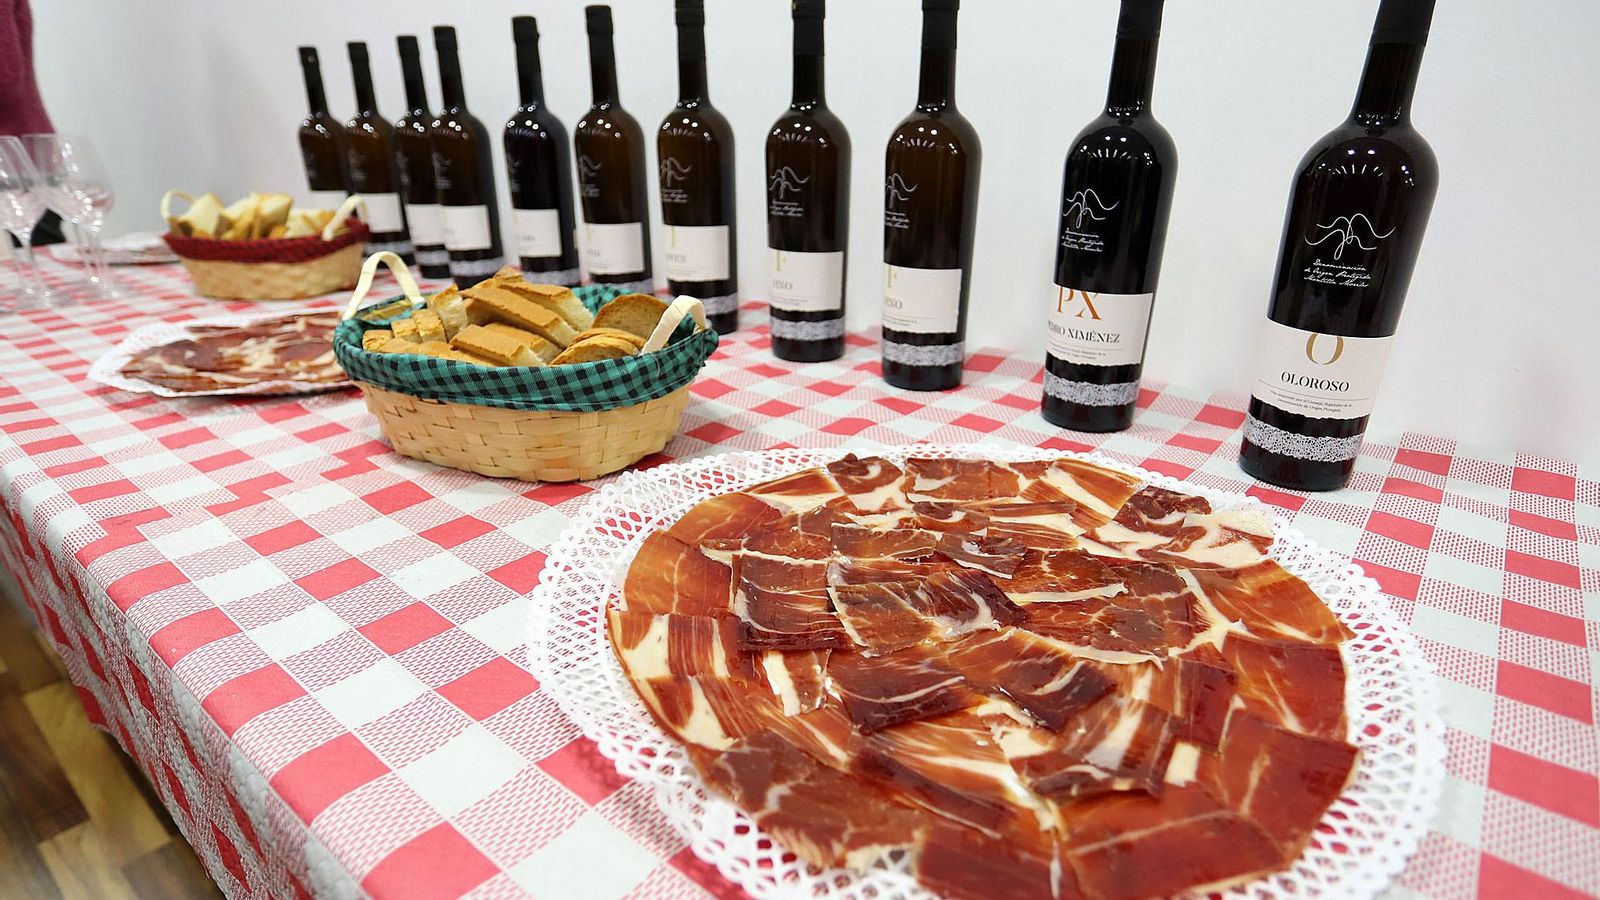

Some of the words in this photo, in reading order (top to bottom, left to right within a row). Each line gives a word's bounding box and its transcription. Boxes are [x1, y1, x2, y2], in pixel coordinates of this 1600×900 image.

[1056, 286, 1103, 321] PX
[1067, 328, 1120, 343] XIMÉNEZ
[1305, 332, 1344, 365] O
[1281, 371, 1350, 392] OLOROSO
